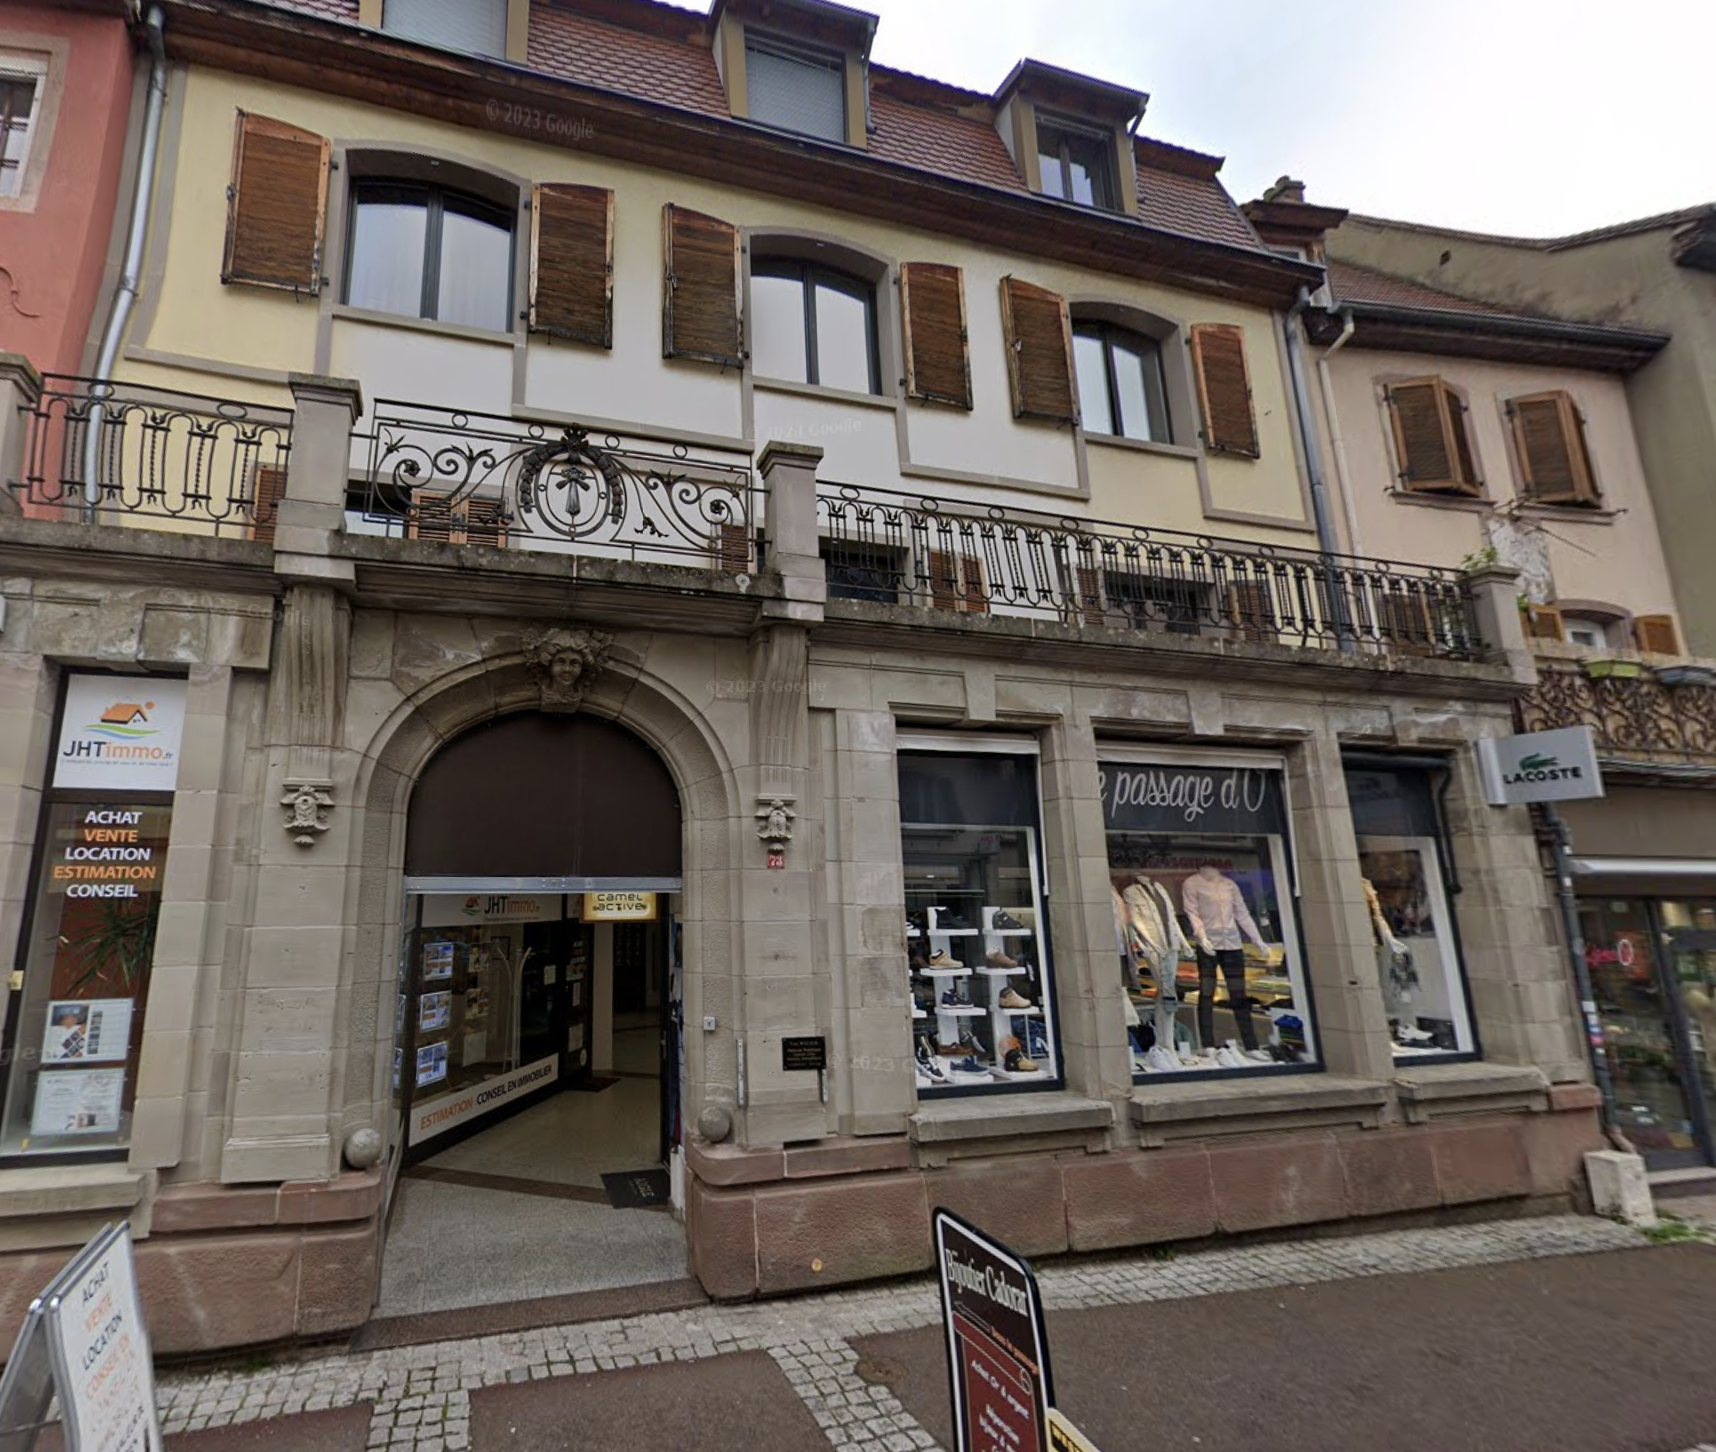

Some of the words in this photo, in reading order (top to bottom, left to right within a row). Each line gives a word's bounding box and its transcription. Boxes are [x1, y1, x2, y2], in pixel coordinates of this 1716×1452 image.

[1503, 766, 1583, 785] LACOSTE
[1112, 770, 1214, 822] passage
[84, 810, 143, 824] ACHAT
[84, 829, 138, 843] VENTE
[64, 847, 150, 861] LOCATION
[769, 854, 783, 867] 73
[53, 865, 156, 879] ESTIMATION
[66, 883, 138, 897] CONSEIL
[421, 1097, 473, 1130] ESTIMATION
[476, 1084, 509, 1105] CONSEIL
[508, 1079, 518, 1093] EN
[517, 1064, 553, 1087] IMMOBILIER
[83, 1311, 123, 1371] LOCATION
